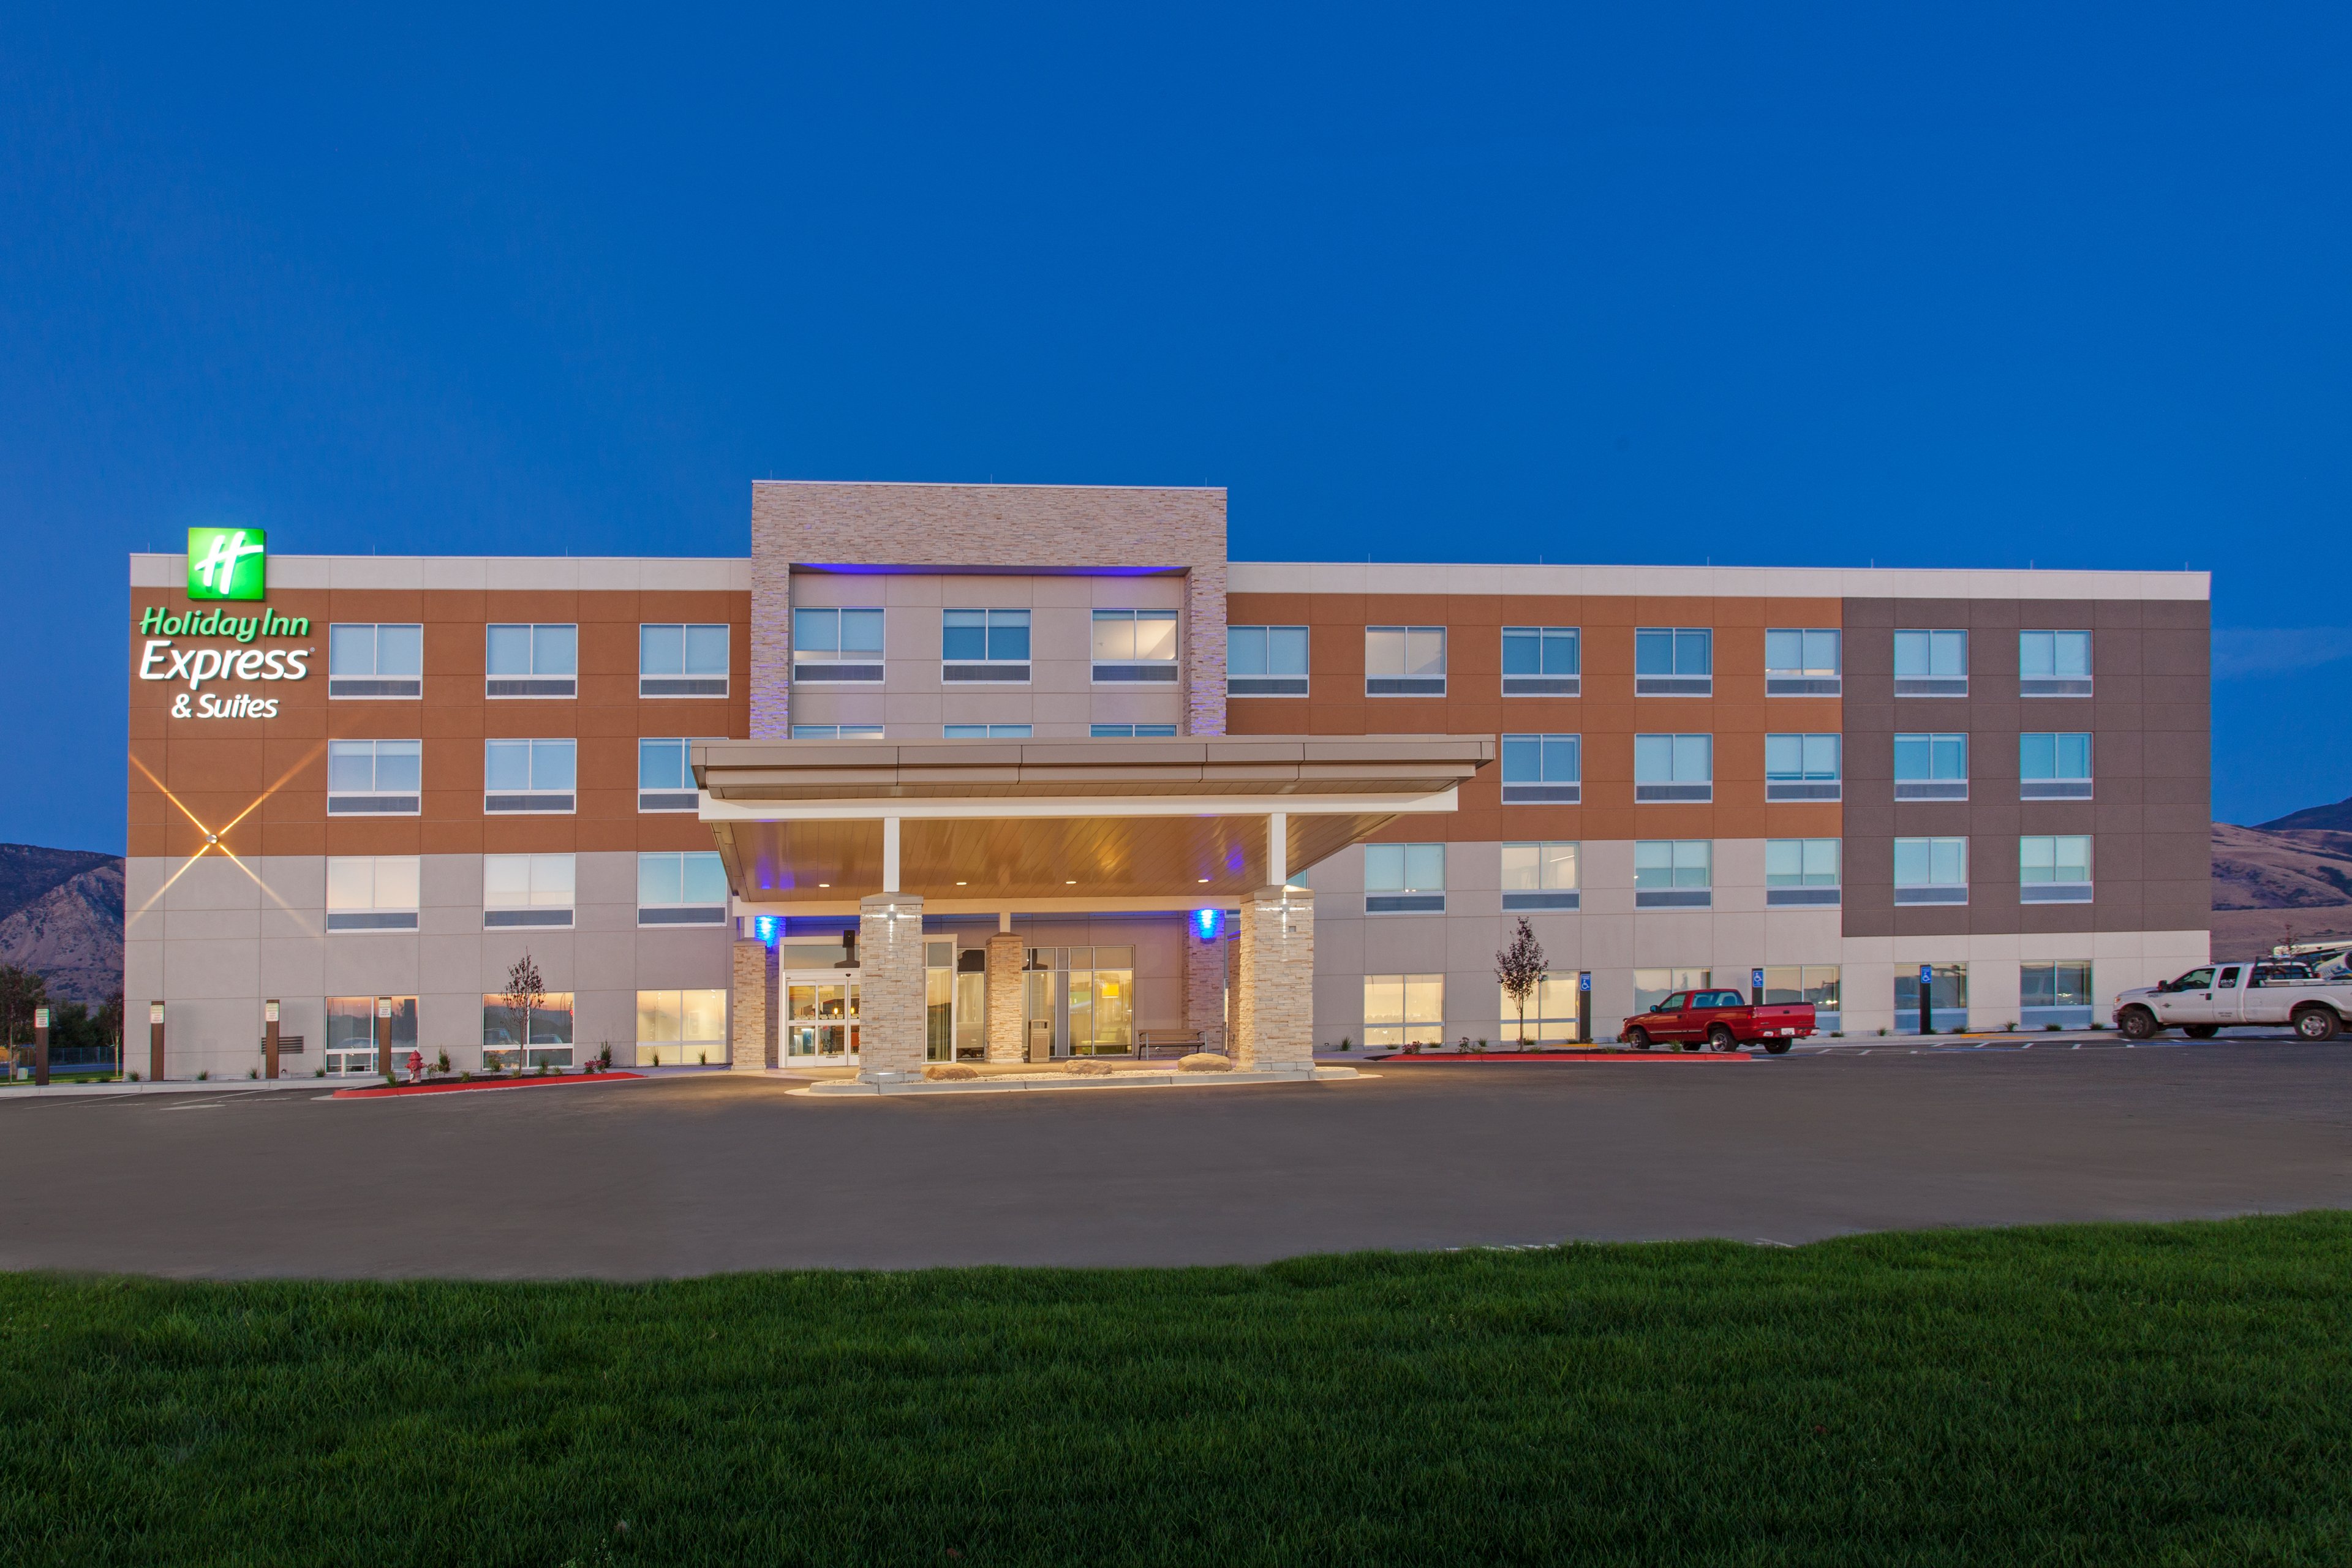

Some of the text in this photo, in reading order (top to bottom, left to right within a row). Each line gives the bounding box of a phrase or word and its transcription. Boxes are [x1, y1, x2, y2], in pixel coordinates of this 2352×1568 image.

[139, 607, 309, 643] Holiday Inn
[139, 640, 309, 690] Express
[171, 693, 279, 718] & Suites
